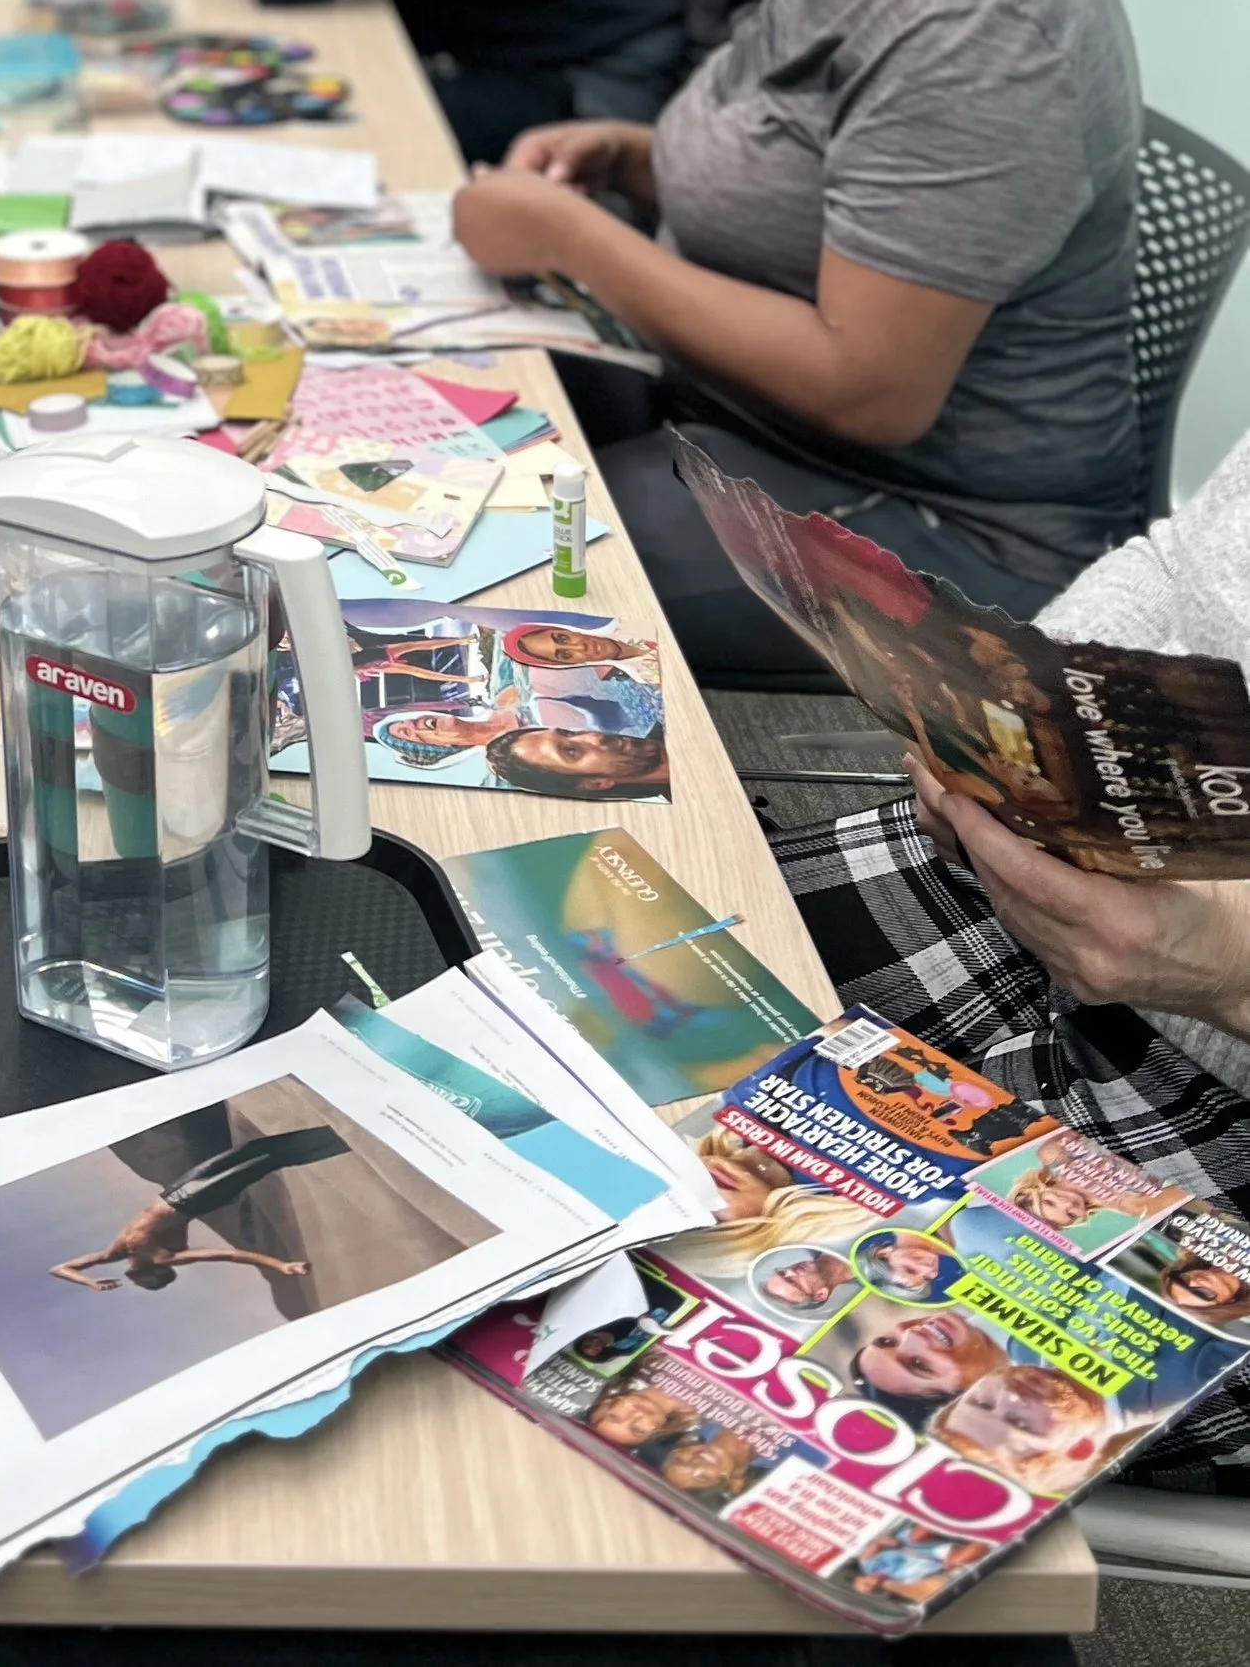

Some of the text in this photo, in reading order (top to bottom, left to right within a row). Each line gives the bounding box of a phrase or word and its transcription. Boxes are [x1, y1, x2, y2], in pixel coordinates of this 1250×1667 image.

[36, 662, 125, 709] araven
[1062, 667, 1167, 870] love where you live
[592, 844, 658, 902] GUERNSEY
[855, 1088, 897, 1115] FASHION
[892, 1110, 921, 1129] GOTH
[755, 1071, 956, 1191] FOR STRICKEN STAR
[866, 1105, 925, 1142] HALLOWEEN
[719, 1108, 897, 1214] HOLLY & DAN IN CRISIS
[741, 1088, 930, 1202] MORE HEARTACHE
[1053, 1162, 1118, 1204] THE MAN
[1056, 1134, 1161, 1198] HELEN'S TEARS
[1068, 1155, 1127, 1194] DRYING
[970, 1182, 1075, 1251] STRICTLY CONFIDENTIAL
[1171, 1215, 1223, 1249] SAVED
[967, 1251, 1024, 1293] their
[1179, 1235, 1240, 1273] POSH'S
[1013, 1281, 1072, 1320] sold
[1070, 1272, 1104, 1294] of
[1003, 1251, 1161, 1355] souls with this
[1095, 1285, 1196, 1353] betrayal
[959, 1280, 1119, 1387] NO SHAME!
[537, 1367, 581, 1397] AFTER
[537, 1387, 582, 1414] SAM'S
[647, 1370, 712, 1414] horrible
[698, 1383, 745, 1413] good
[638, 1297, 1032, 1529] Closer
[704, 1406, 738, 1430] not
[738, 1407, 757, 1421] a
[762, 1486, 792, 1506] gas
[797, 1488, 817, 1504] in
[813, 1497, 841, 1516] me
[837, 1511, 867, 1531] left
